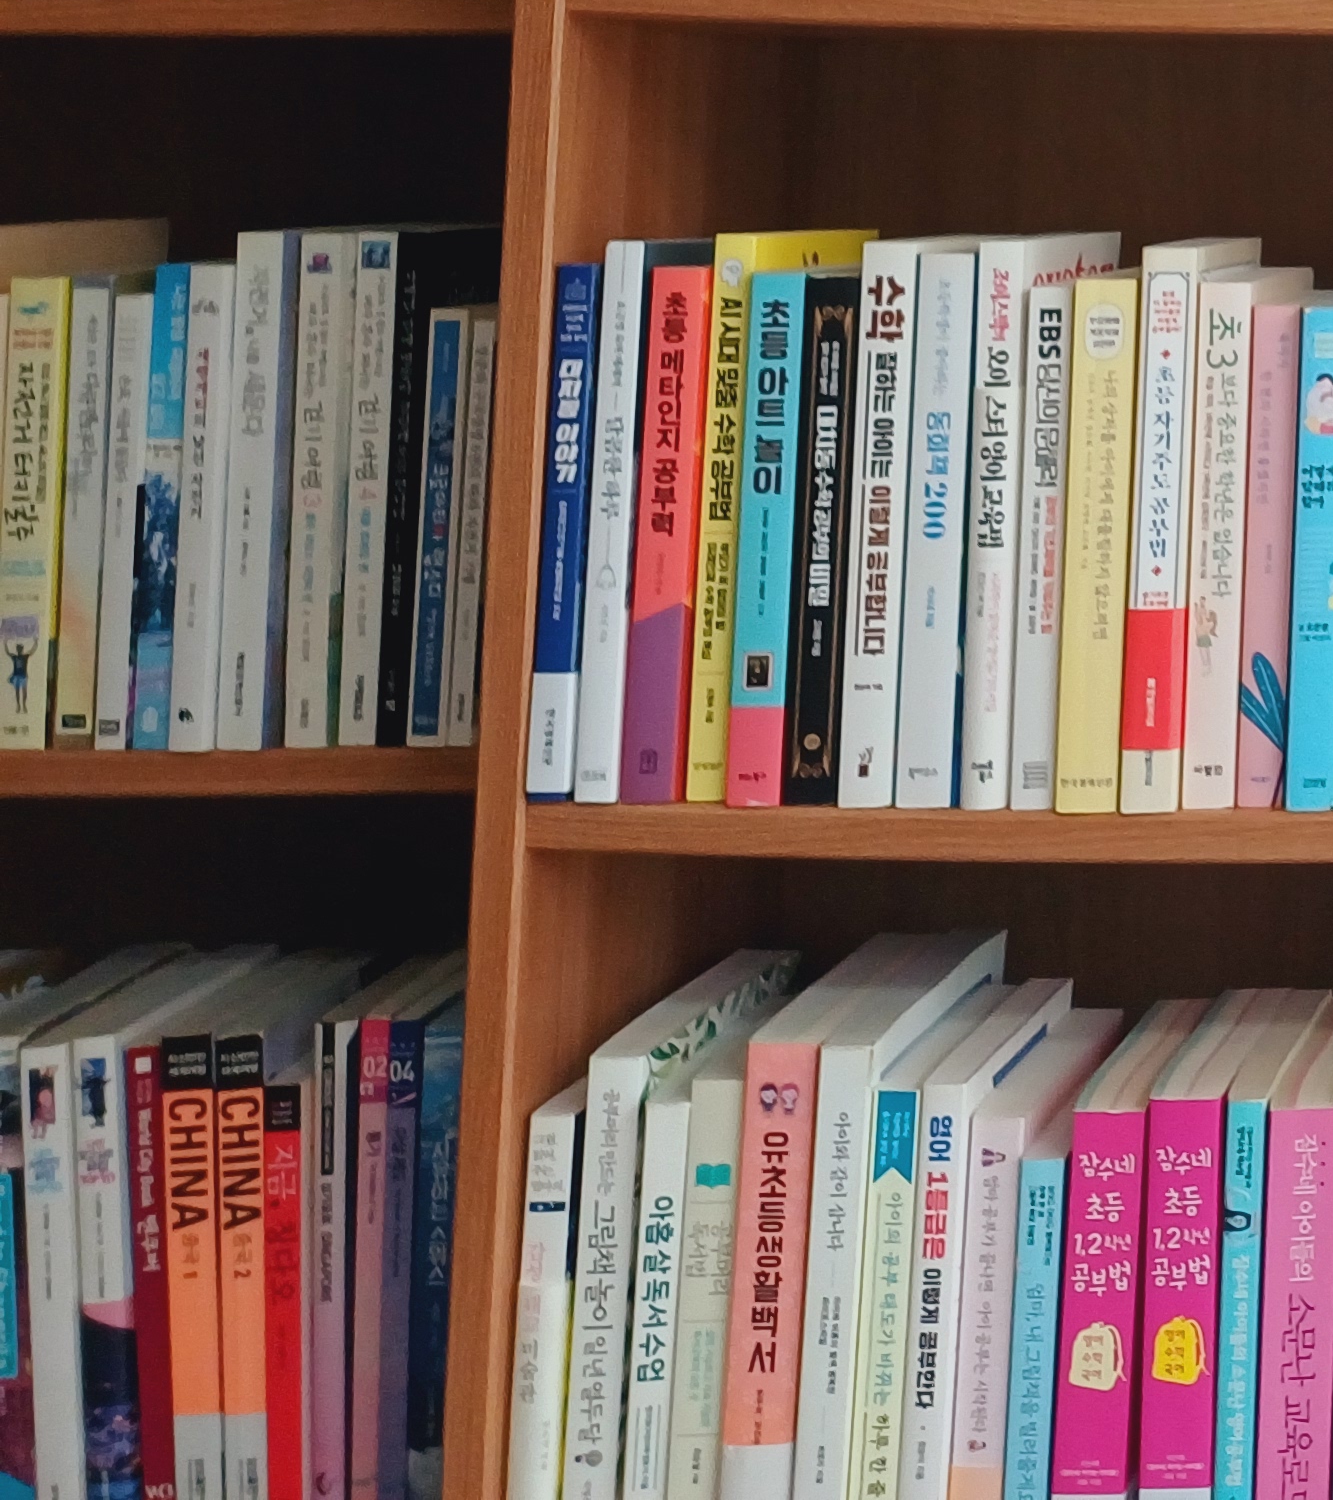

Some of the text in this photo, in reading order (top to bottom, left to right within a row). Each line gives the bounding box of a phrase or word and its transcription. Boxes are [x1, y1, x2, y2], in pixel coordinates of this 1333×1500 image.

[862, 274, 906, 656] 수학 잘하는 아이는 이렇게 공부합니다
[167, 1097, 209, 1232] CHINA
[220, 1097, 261, 1232] CHINA
[1079, 1152, 1136, 1180] 잠수네
[1155, 1145, 1212, 1175] 잠수네
[1084, 1192, 1126, 1223] 초등
[1163, 1186, 1203, 1218] 초등
[1288, 1201, 1314, 1283] 아이들의
[1069, 1261, 1133, 1298] 공부법
[1150, 1255, 1212, 1291] 공부법
[1281, 1293, 1316, 1387] 소문난
